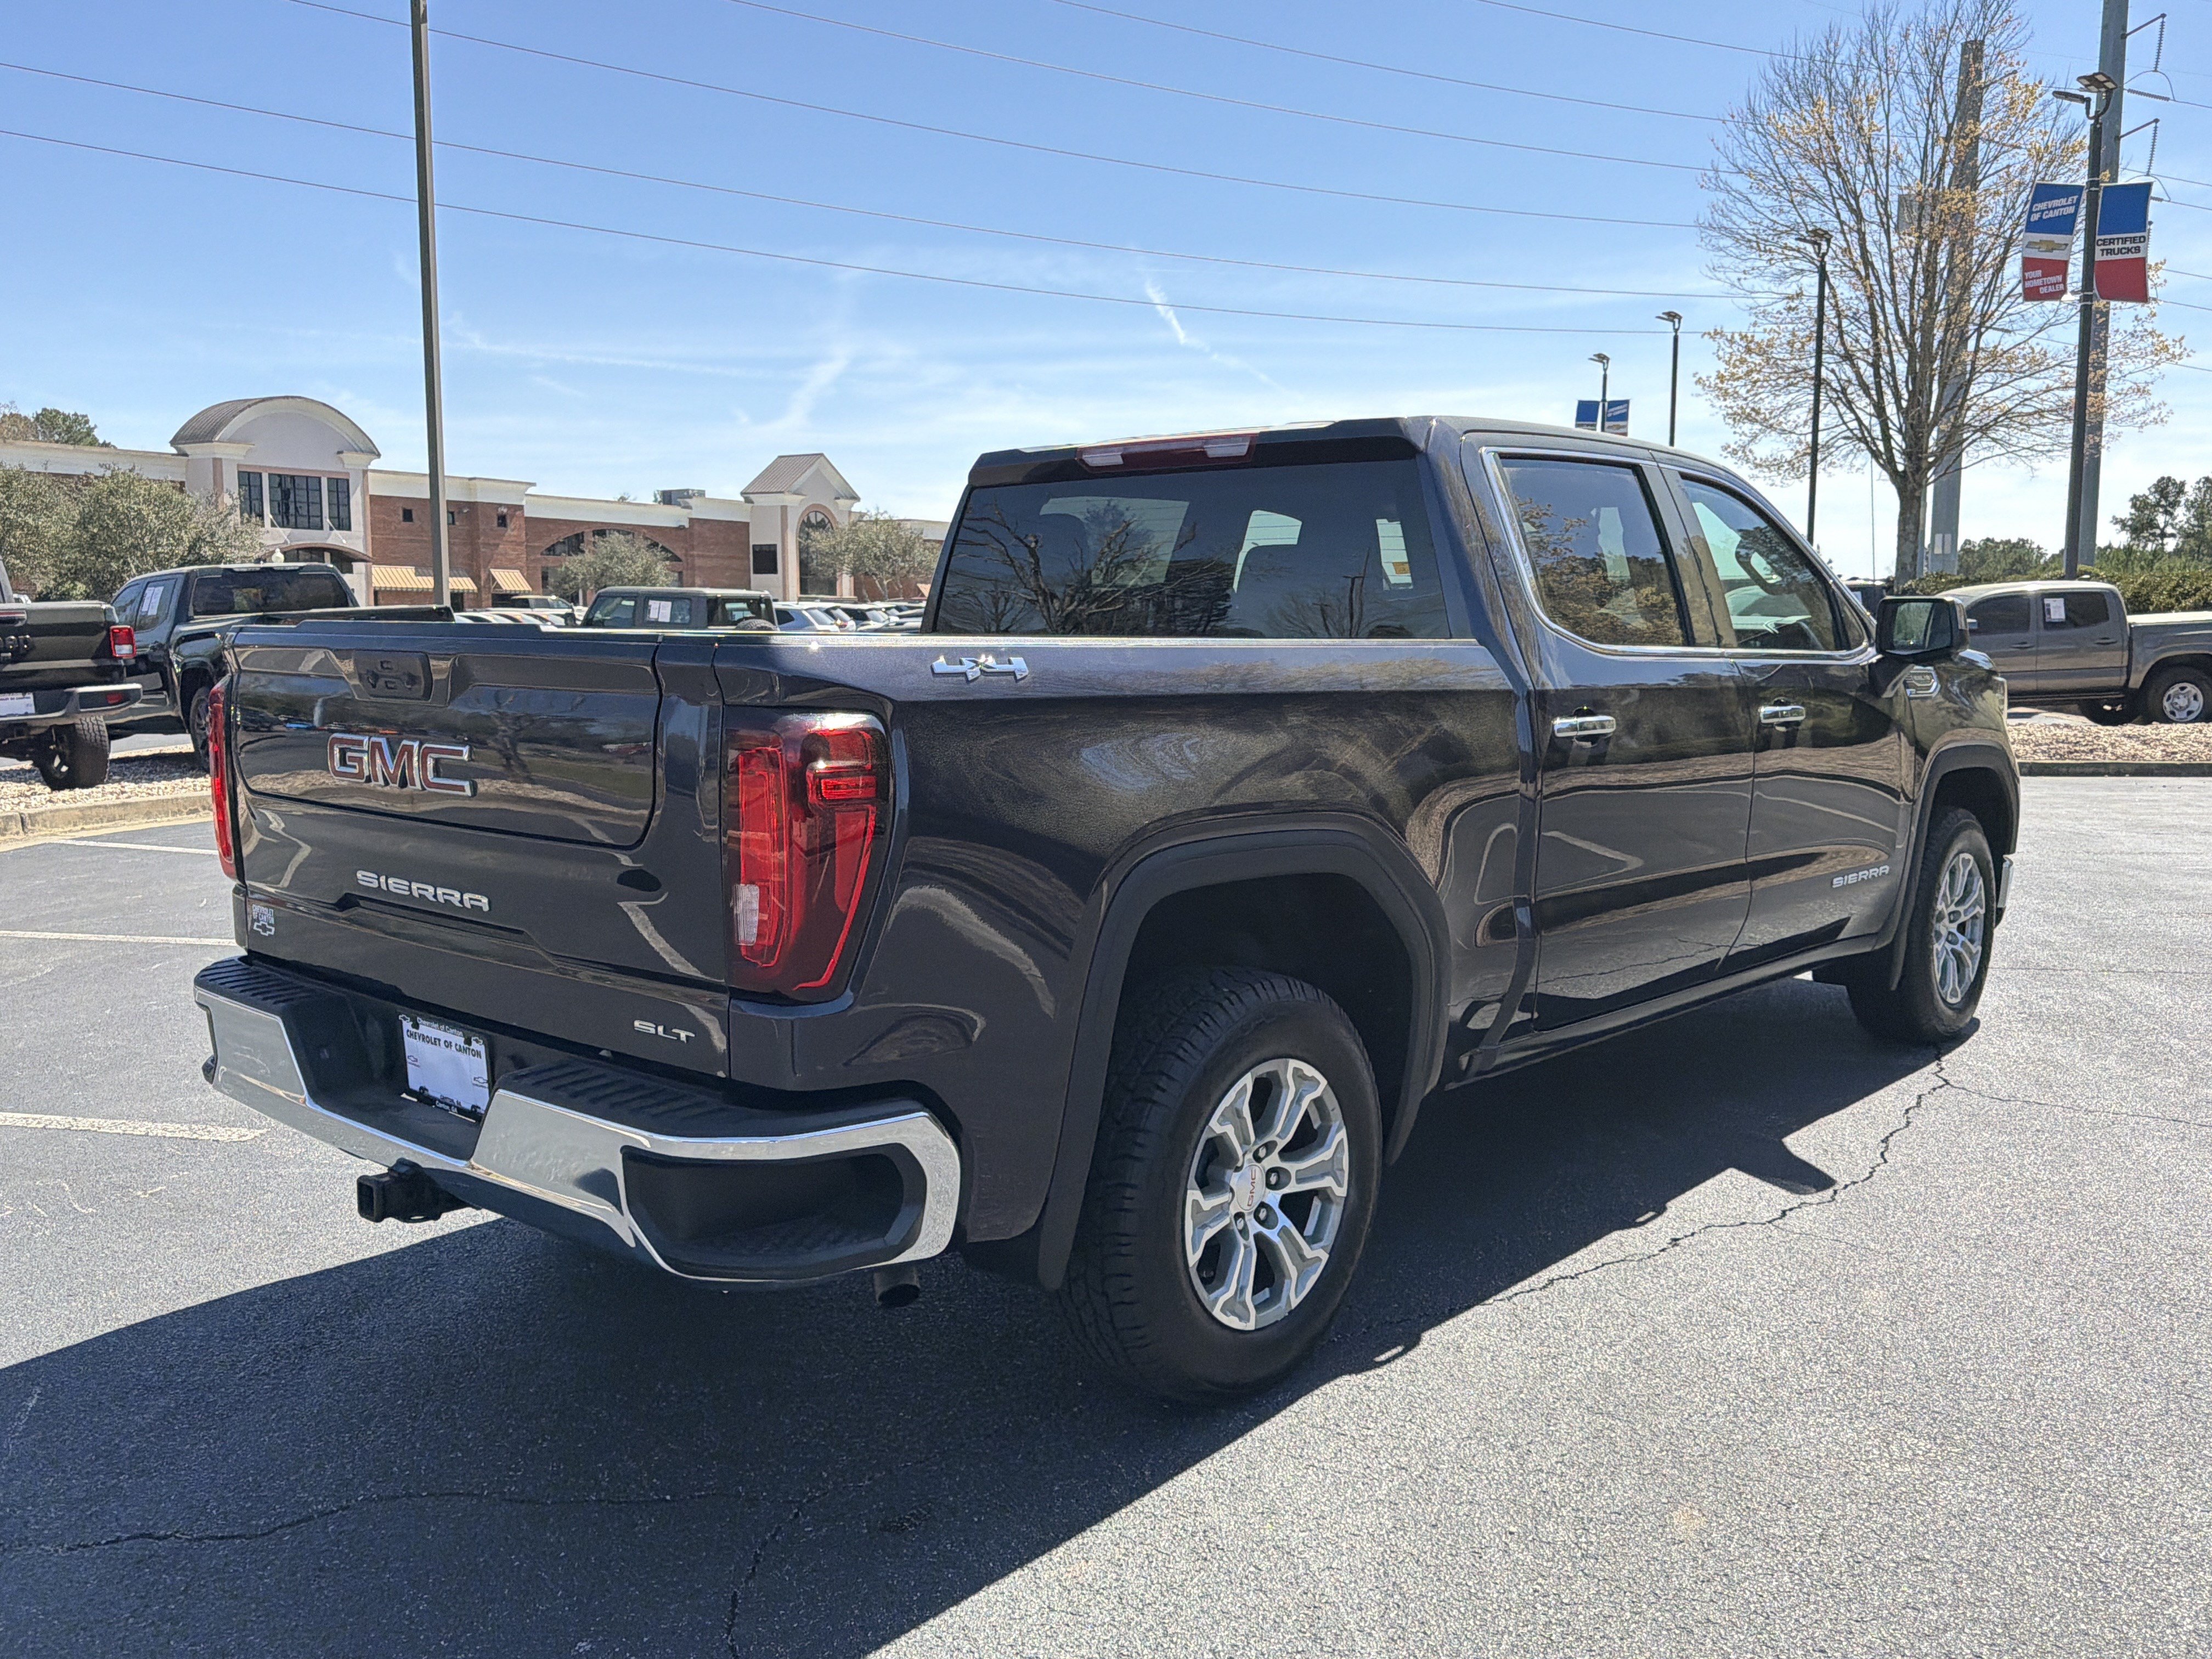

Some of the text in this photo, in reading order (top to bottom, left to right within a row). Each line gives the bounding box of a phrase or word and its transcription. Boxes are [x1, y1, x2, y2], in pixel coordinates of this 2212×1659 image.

[2032, 195, 2079, 211] CHEVROLET
[2030, 206, 2075, 222] OF CANTON
[2096, 235, 2146, 247] CERTIFIED
[2100, 246, 2141, 256] TRUCKS
[2024, 270, 2042, 279] YOUR
[2025, 274, 2063, 288] HOMETOWN
[2040, 284, 2064, 294] DEALER
[328, 732, 475, 797] GMC
[1832, 865, 1890, 888] SIERRA
[357, 870, 490, 912] SIERRA
[252, 904, 274, 917] CHEVROLET
[634, 1020, 695, 1043] SLT
[406, 1029, 482, 1059] CHEVROLET OF CANTON
[1247, 1169, 1256, 1206] GMC
